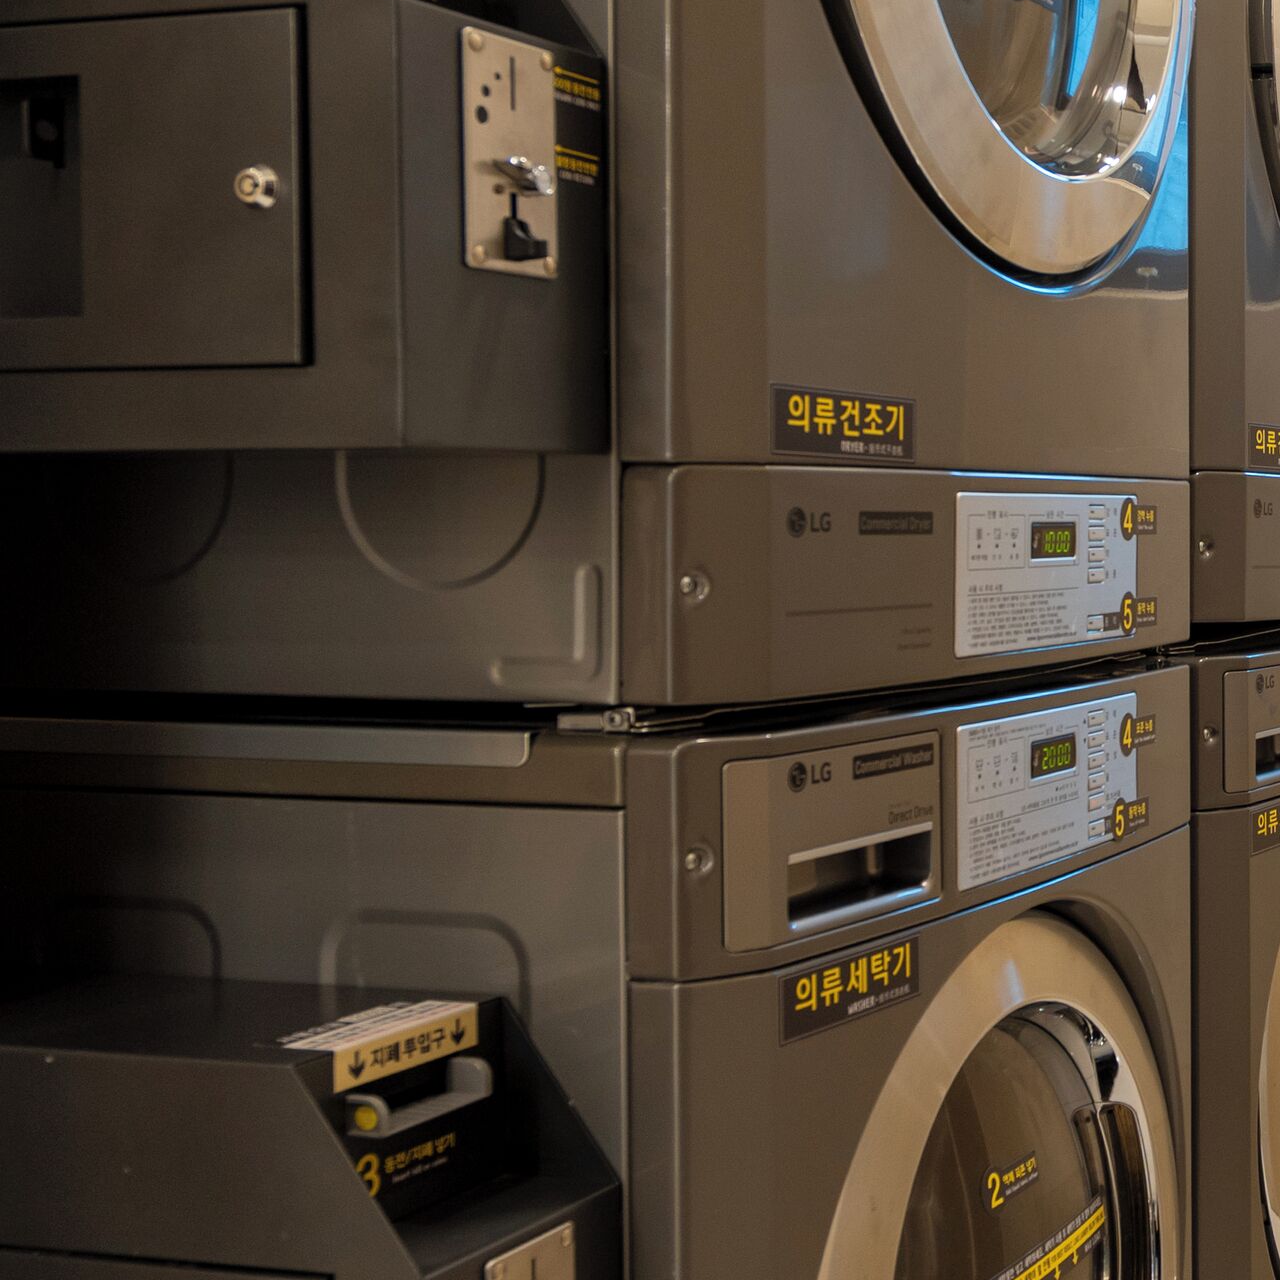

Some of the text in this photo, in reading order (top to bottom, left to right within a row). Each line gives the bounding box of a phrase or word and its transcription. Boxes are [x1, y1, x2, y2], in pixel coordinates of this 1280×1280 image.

[787, 394, 905, 441] 의류건조기
[1123, 503, 1133, 533] 4
[1123, 599, 1132, 630] 5
[1122, 719, 1132, 749] 4
[1115, 804, 1125, 836] 5
[795, 942, 911, 1012] 의류세탁기
[355, 1152, 381, 1198] 3
[988, 1172, 1004, 1209] 2
